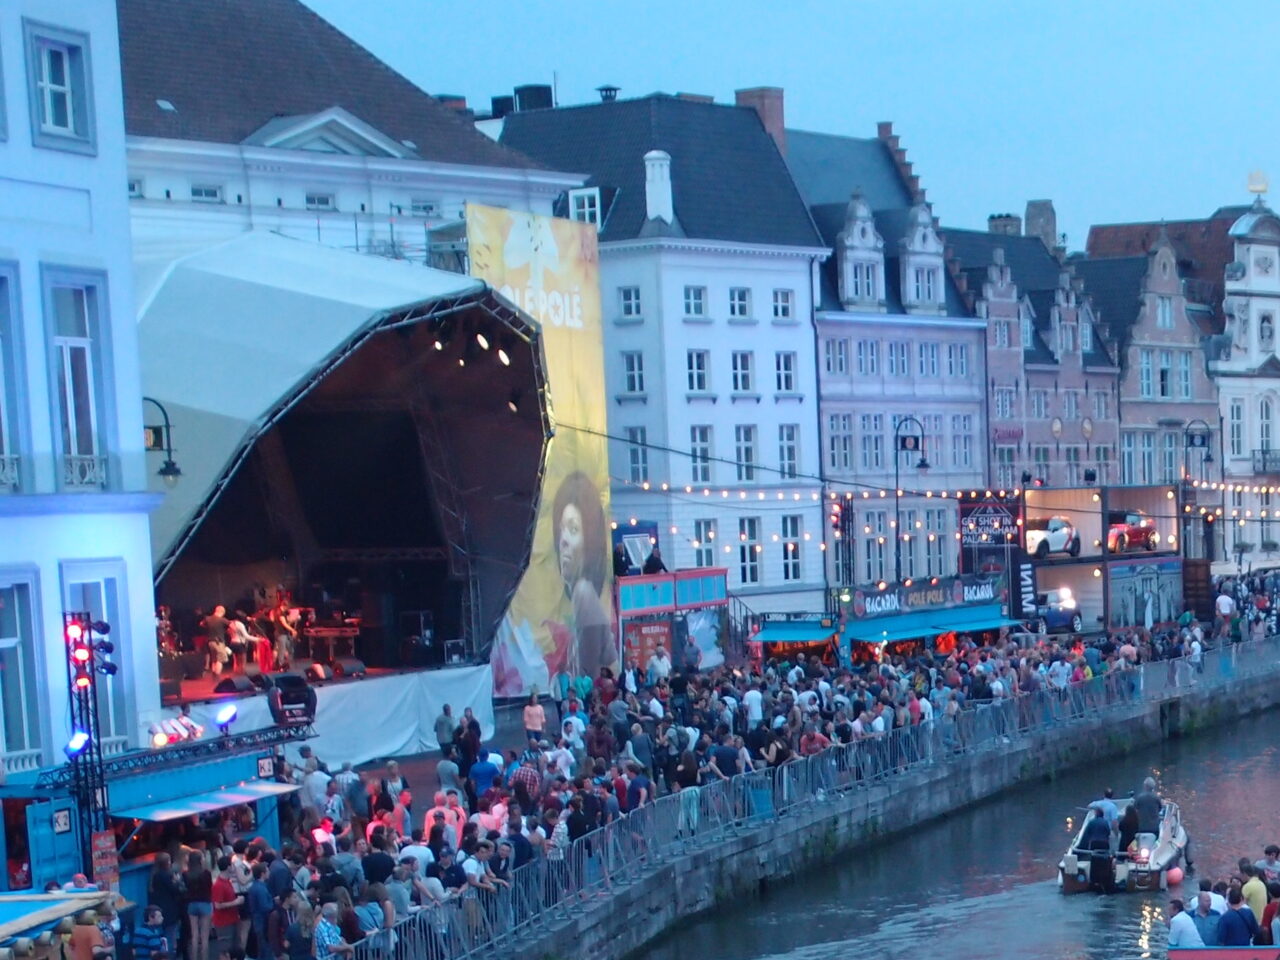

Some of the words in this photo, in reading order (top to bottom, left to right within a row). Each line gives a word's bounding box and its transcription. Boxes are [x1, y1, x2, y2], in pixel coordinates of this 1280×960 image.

[537, 283, 584, 328] POLÉ
[962, 517, 977, 526] GET
[979, 516, 1001, 526] SHOT
[1002, 517, 1011, 525] IN
[1020, 564, 1035, 612] MINI
[55, 815, 61, 826] K
